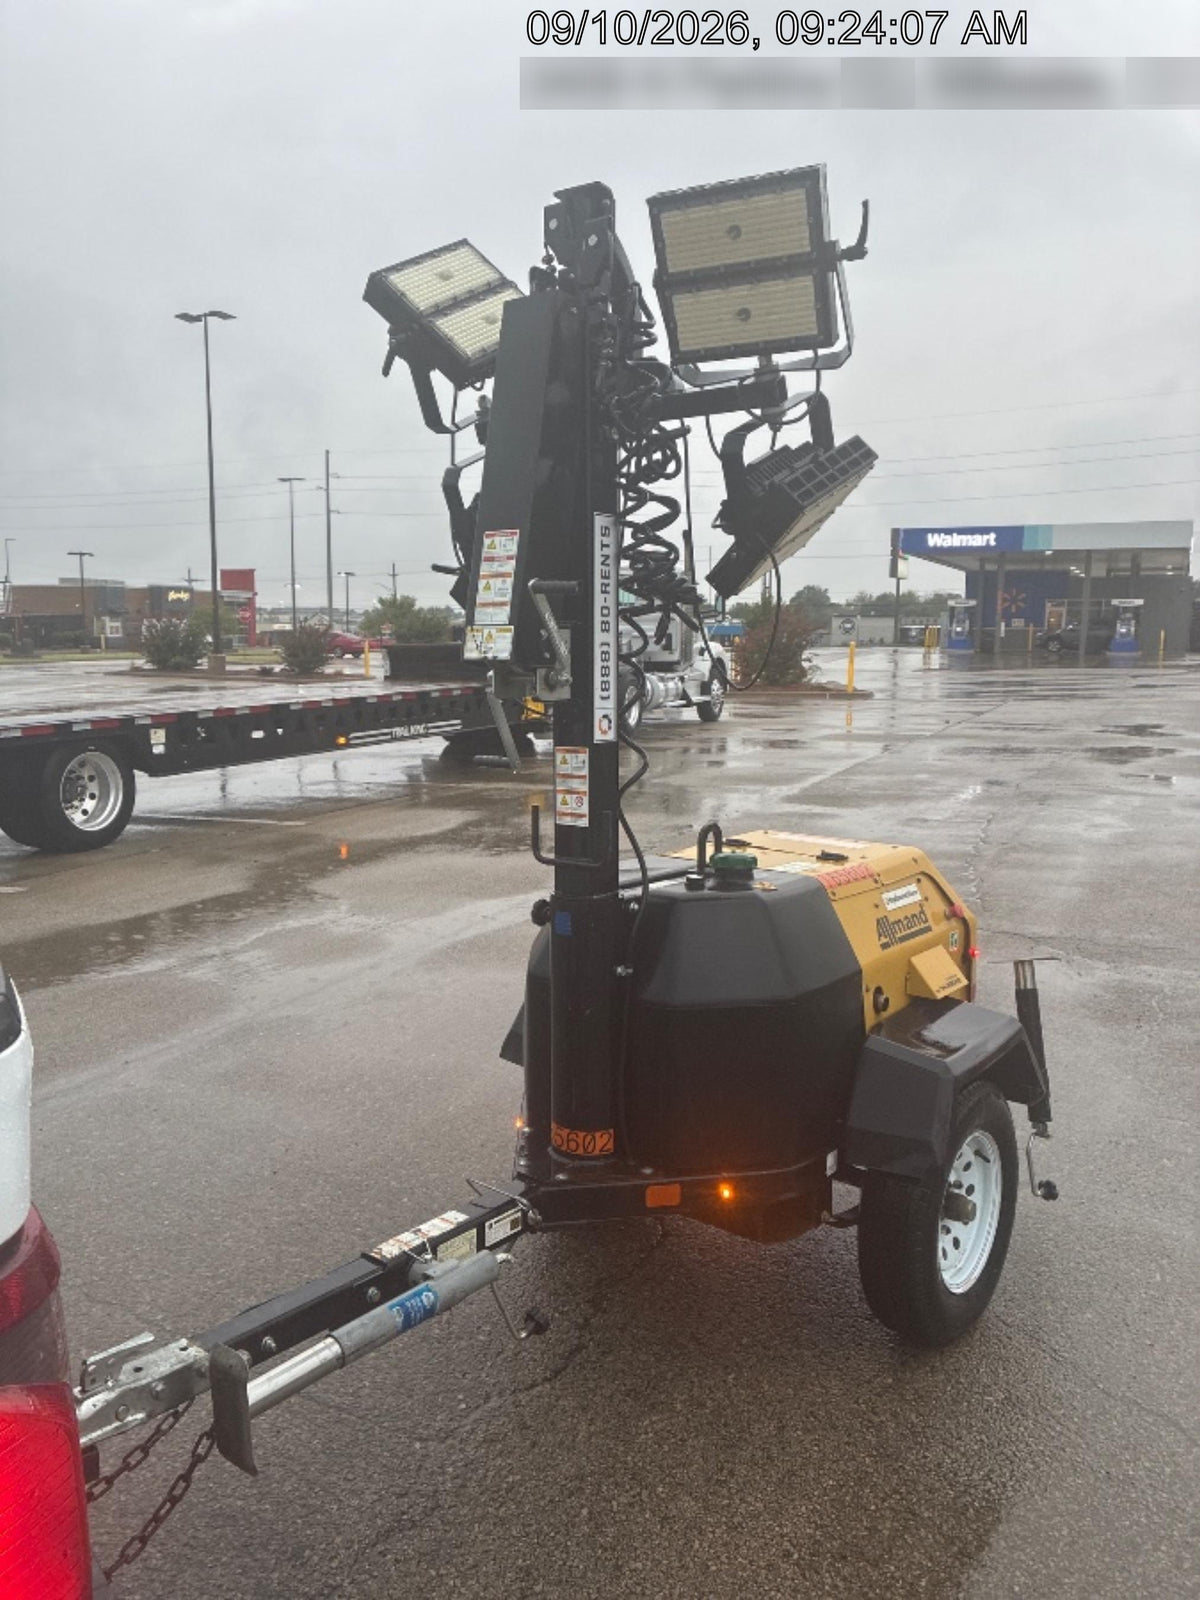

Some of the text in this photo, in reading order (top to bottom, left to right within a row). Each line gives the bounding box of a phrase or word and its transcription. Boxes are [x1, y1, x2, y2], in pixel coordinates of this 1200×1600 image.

[927, 532, 997, 547] Walmart
[600, 525, 611, 701] (888) 80-RENTS
[876, 904, 929, 945] Allmand
